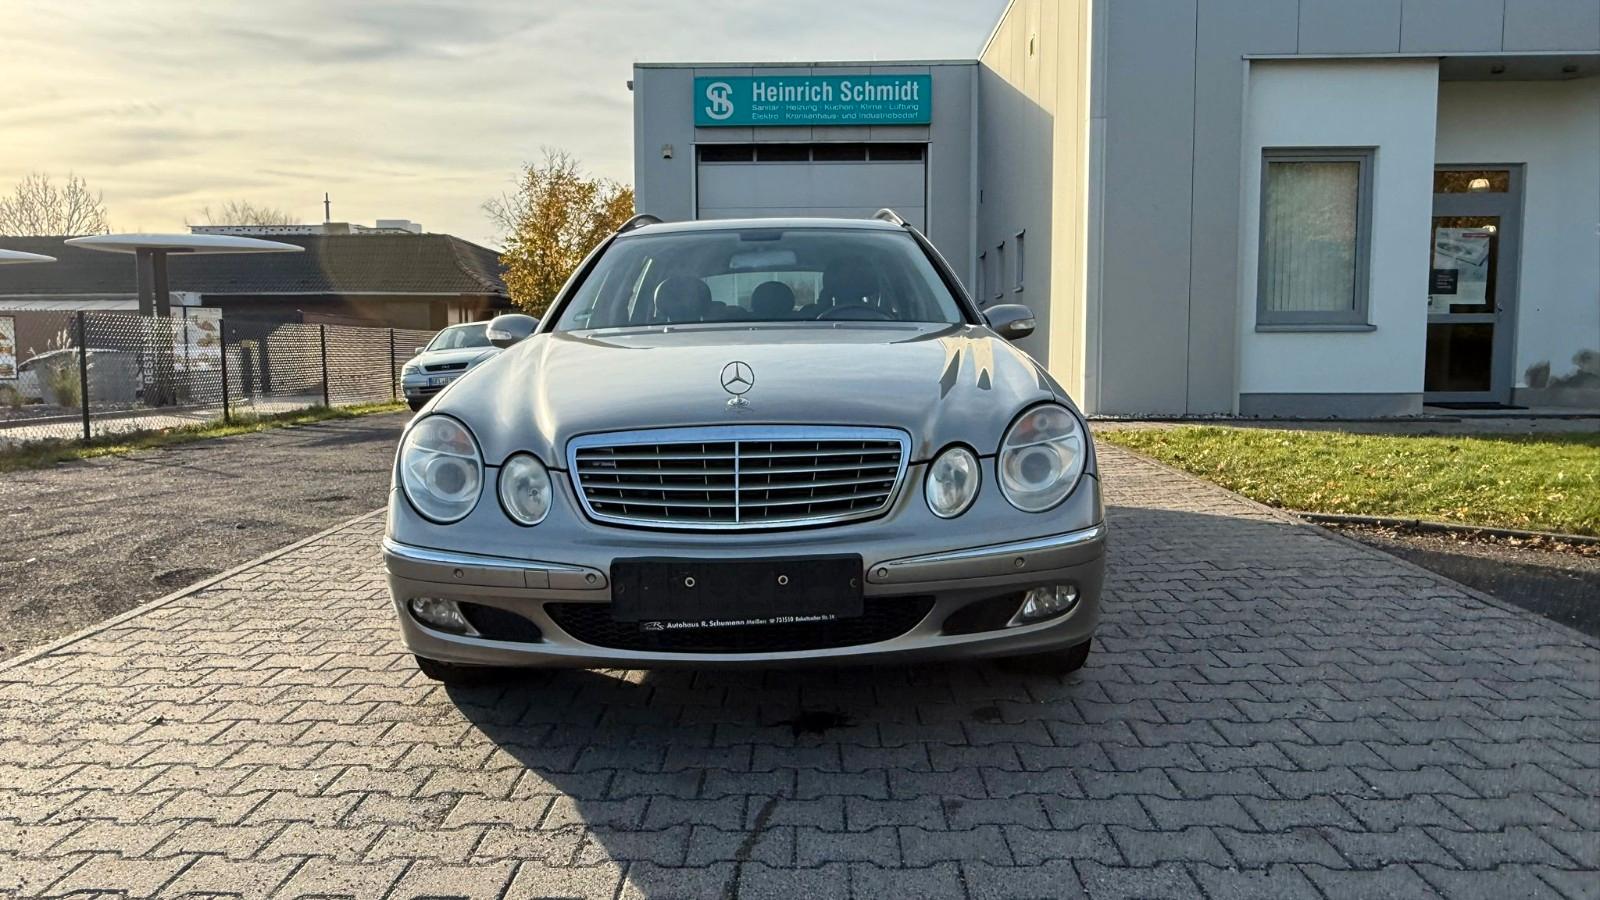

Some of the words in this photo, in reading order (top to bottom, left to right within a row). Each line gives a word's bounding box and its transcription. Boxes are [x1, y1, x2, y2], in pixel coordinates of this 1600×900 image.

[752, 81, 832, 102] Heinrich
[840, 80, 919, 102] Schmidt
[751, 112, 780, 120] Elektro
[841, 112, 857, 120] und
[666, 621, 699, 629] Autohaus
[709, 619, 745, 627] Schumann
